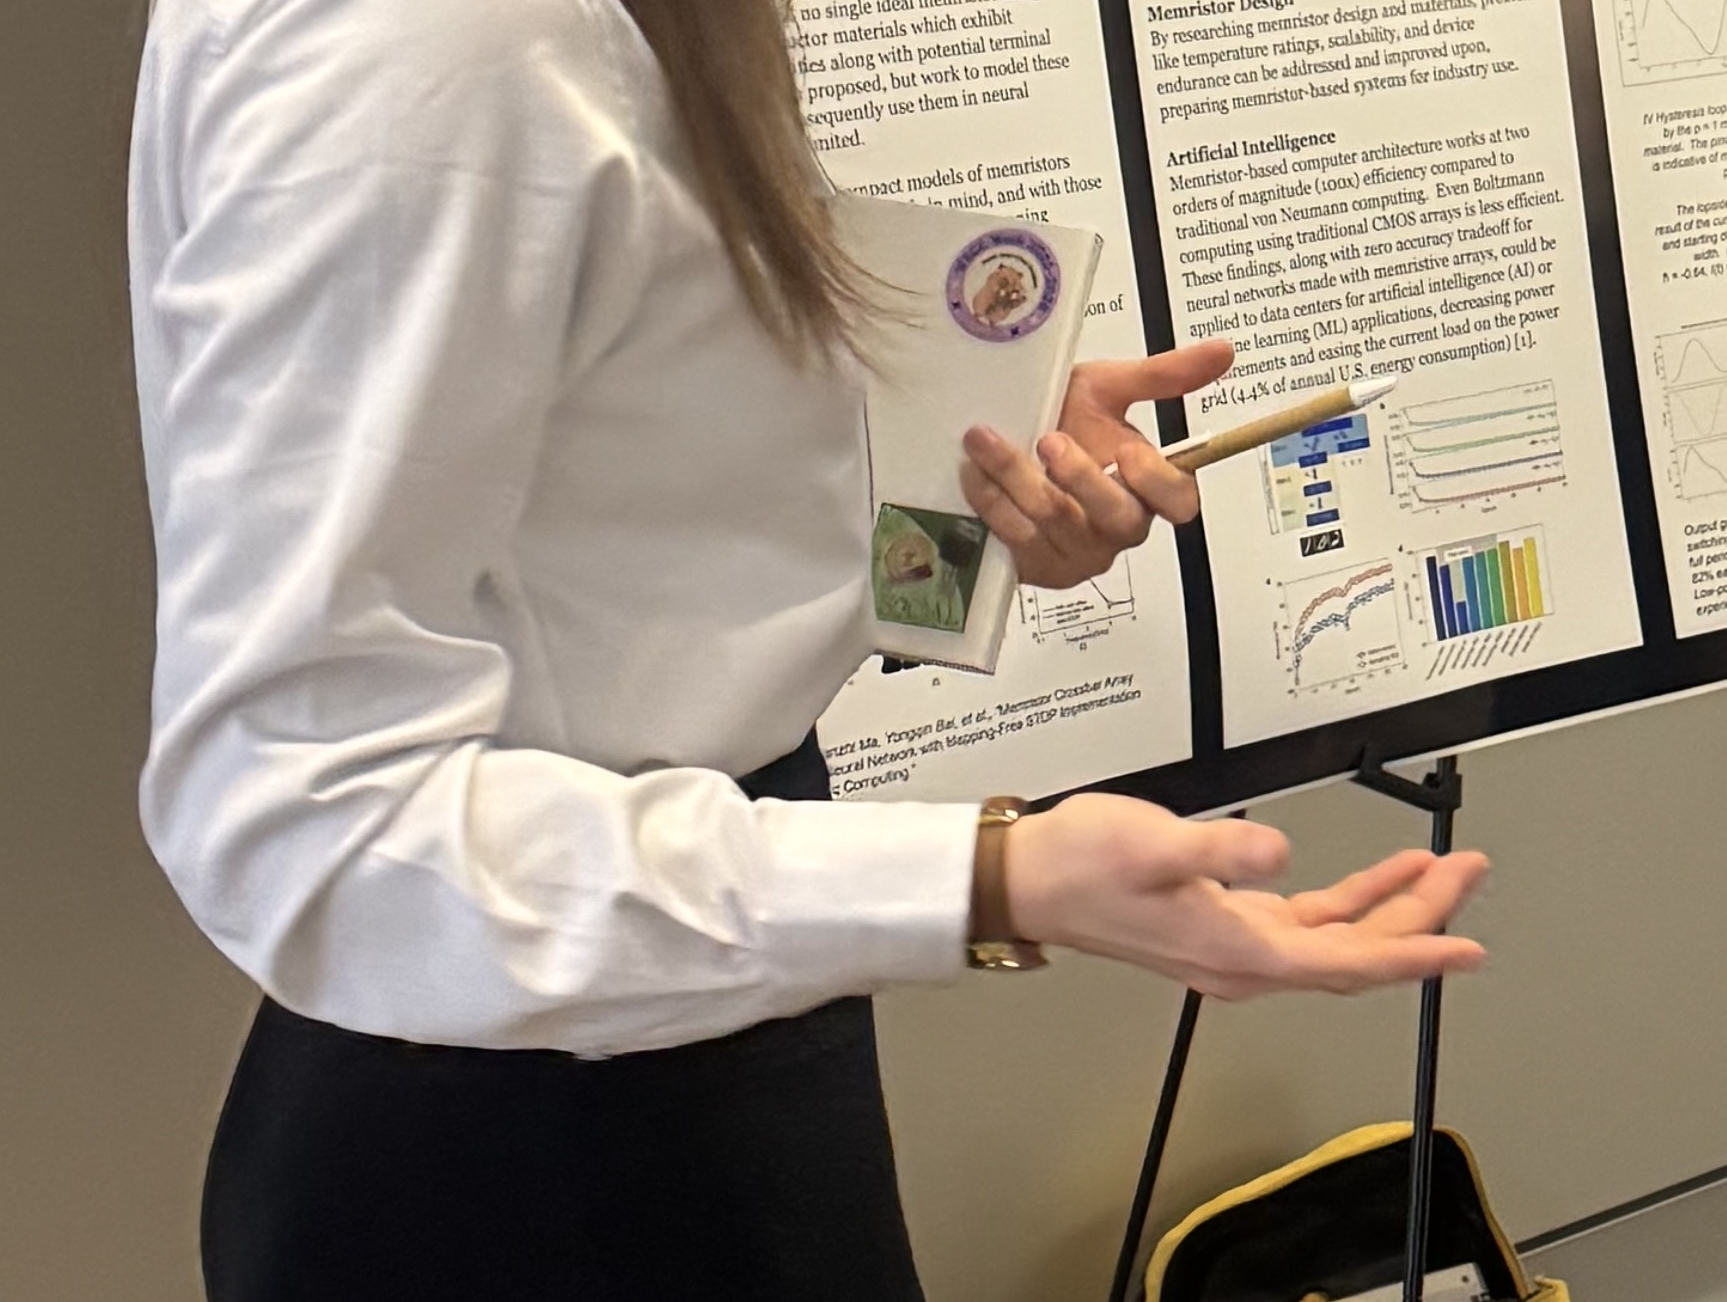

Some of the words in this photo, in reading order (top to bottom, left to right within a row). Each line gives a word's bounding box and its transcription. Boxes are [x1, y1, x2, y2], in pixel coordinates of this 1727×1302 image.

[800, 7, 821, 21] no
[833, 21, 907, 43] materials
[910, 15, 957, 34] which
[960, 8, 1013, 29] exhibit
[1147, 0, 1235, 22] Memristor
[1166, 141, 1238, 167] Artificial
[1241, 132, 1335, 155] Intelligence
[1168, 157, 1288, 191] Memristor-based
[1291, 151, 1357, 173] computer
[1361, 139, 1442, 162] architecture
[1445, 129, 1485, 149] works
[1489, 128, 1502, 143] at
[1504, 126, 1529, 141] two
[906, 167, 964, 191] models
[967, 163, 983, 182] of
[986, 156, 1070, 179] memristors
[1172, 196, 1217, 215] orders
[1220, 189, 1234, 207] of
[1238, 179, 1311, 206] magnitude
[1314, 171, 1359, 195] (100x)
[1362, 165, 1427, 185] efficiency
[1430, 151, 1497, 175] compared
[1499, 151, 1514, 165] to
[1175, 212, 1248, 239] traditional
[1251, 212, 1277, 226] von
[1279, 201, 1348, 222] Neumann
[1351, 187, 1429, 211] computing.
[1435, 182, 1469, 198] Even
[1472, 170, 1544, 192] Boltzmann
